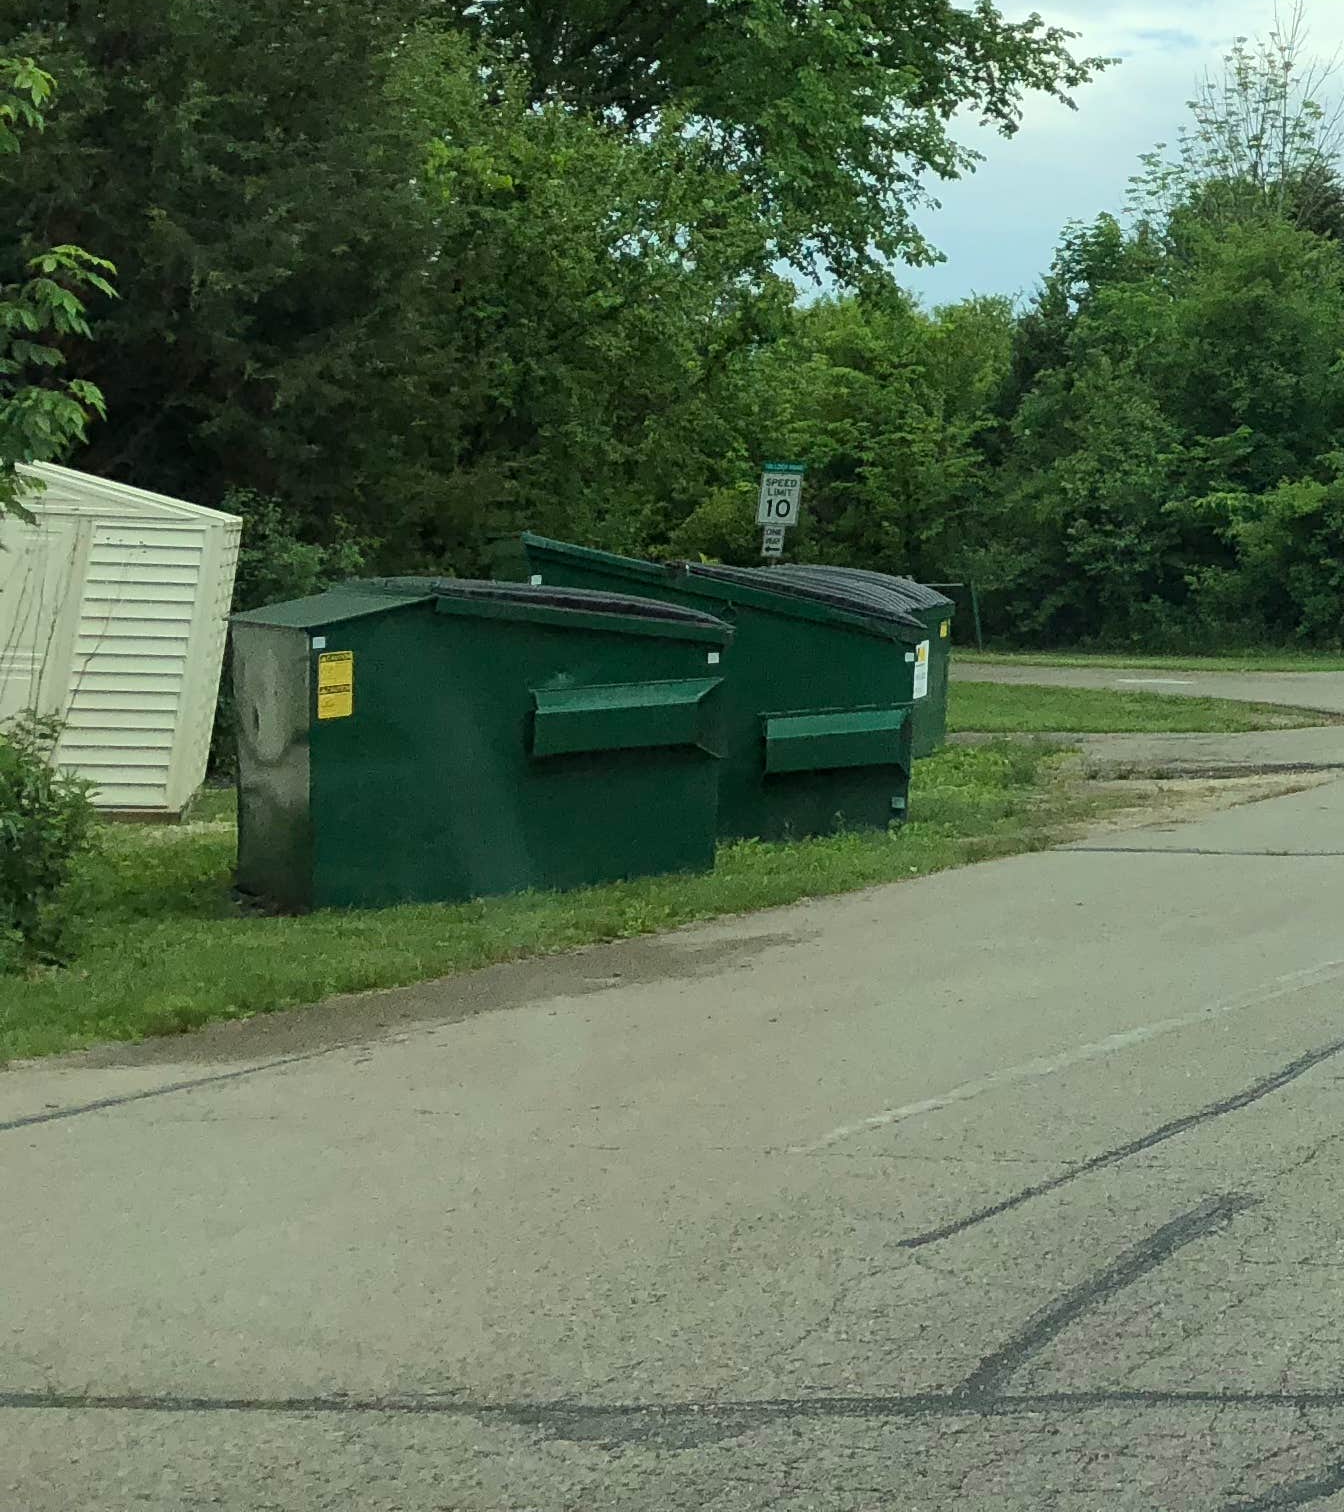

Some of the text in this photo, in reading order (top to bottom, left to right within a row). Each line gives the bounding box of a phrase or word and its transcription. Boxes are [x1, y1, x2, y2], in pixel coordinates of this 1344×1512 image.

[766, 478, 798, 488] SPEED
[767, 488, 793, 497] LIMIT
[766, 499, 791, 518] 10
